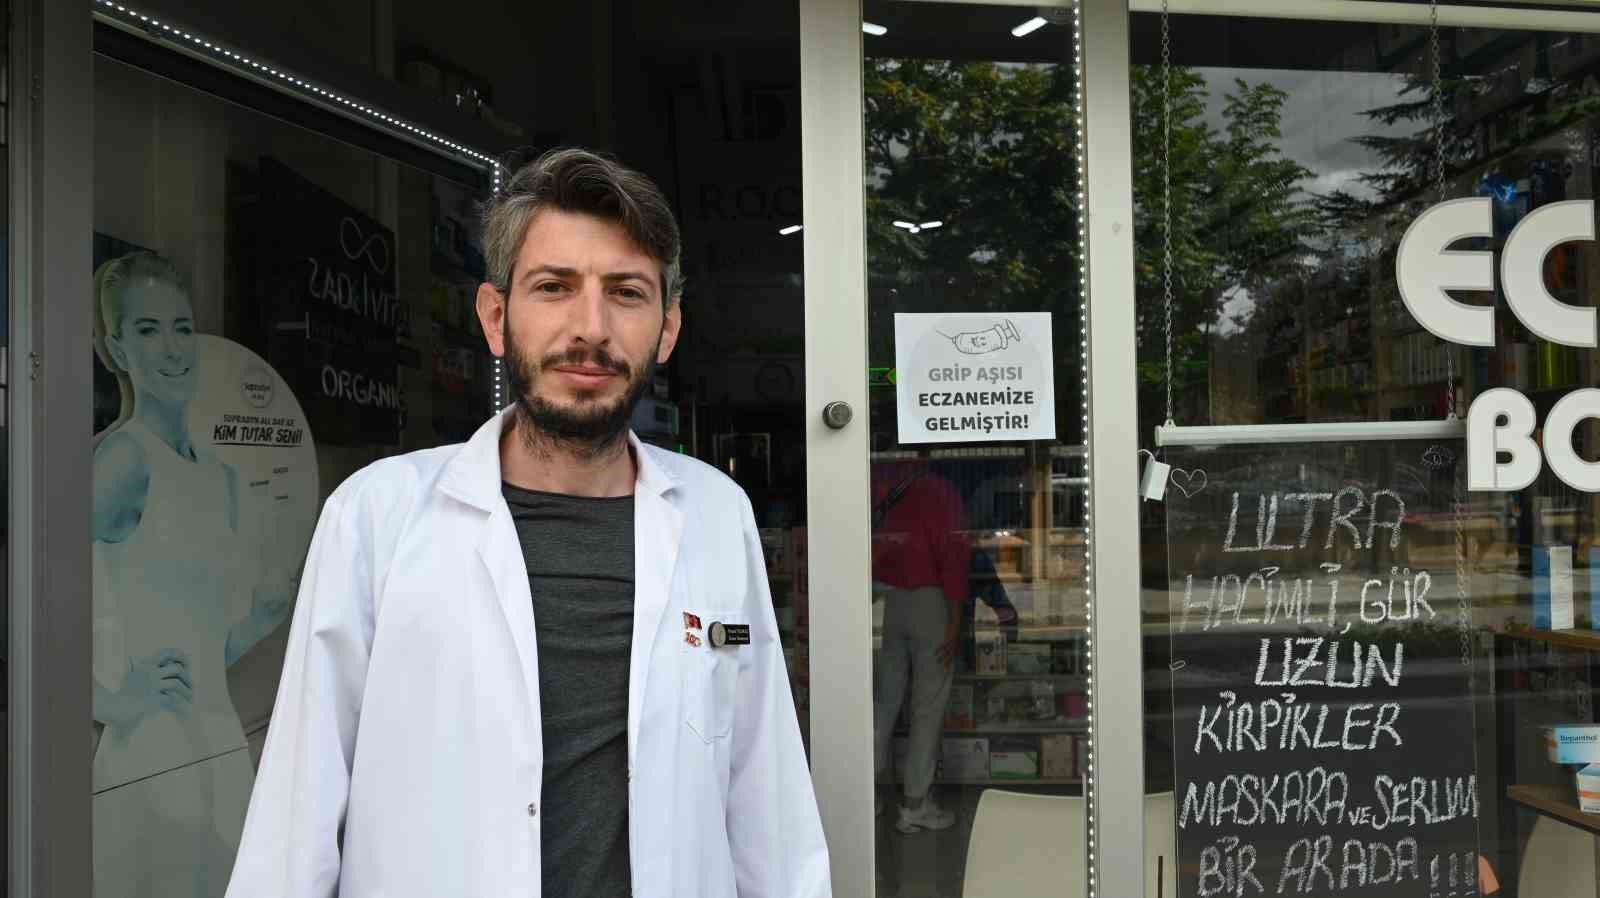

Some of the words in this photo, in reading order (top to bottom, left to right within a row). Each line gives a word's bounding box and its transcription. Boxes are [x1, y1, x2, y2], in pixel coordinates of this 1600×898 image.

[918, 386, 1034, 407] ECZANEMİZE
[929, 363, 972, 382] GRİP
[976, 366, 1023, 385] AŞISI
[240, 426, 273, 442] TUTAR
[925, 411, 1029, 434] GELMİŞTİR!
[1222, 486, 1405, 553] ULTRA
[1360, 566, 1436, 624] GÜR
[1254, 636, 1403, 688] UZUN
[1194, 690, 1402, 754] KİRPİKLER
[1179, 766, 1348, 829] MASKARA
[1371, 774, 1479, 830] SERUM
[1198, 836, 1264, 898] BİR
[1276, 835, 1419, 894] ARADA
